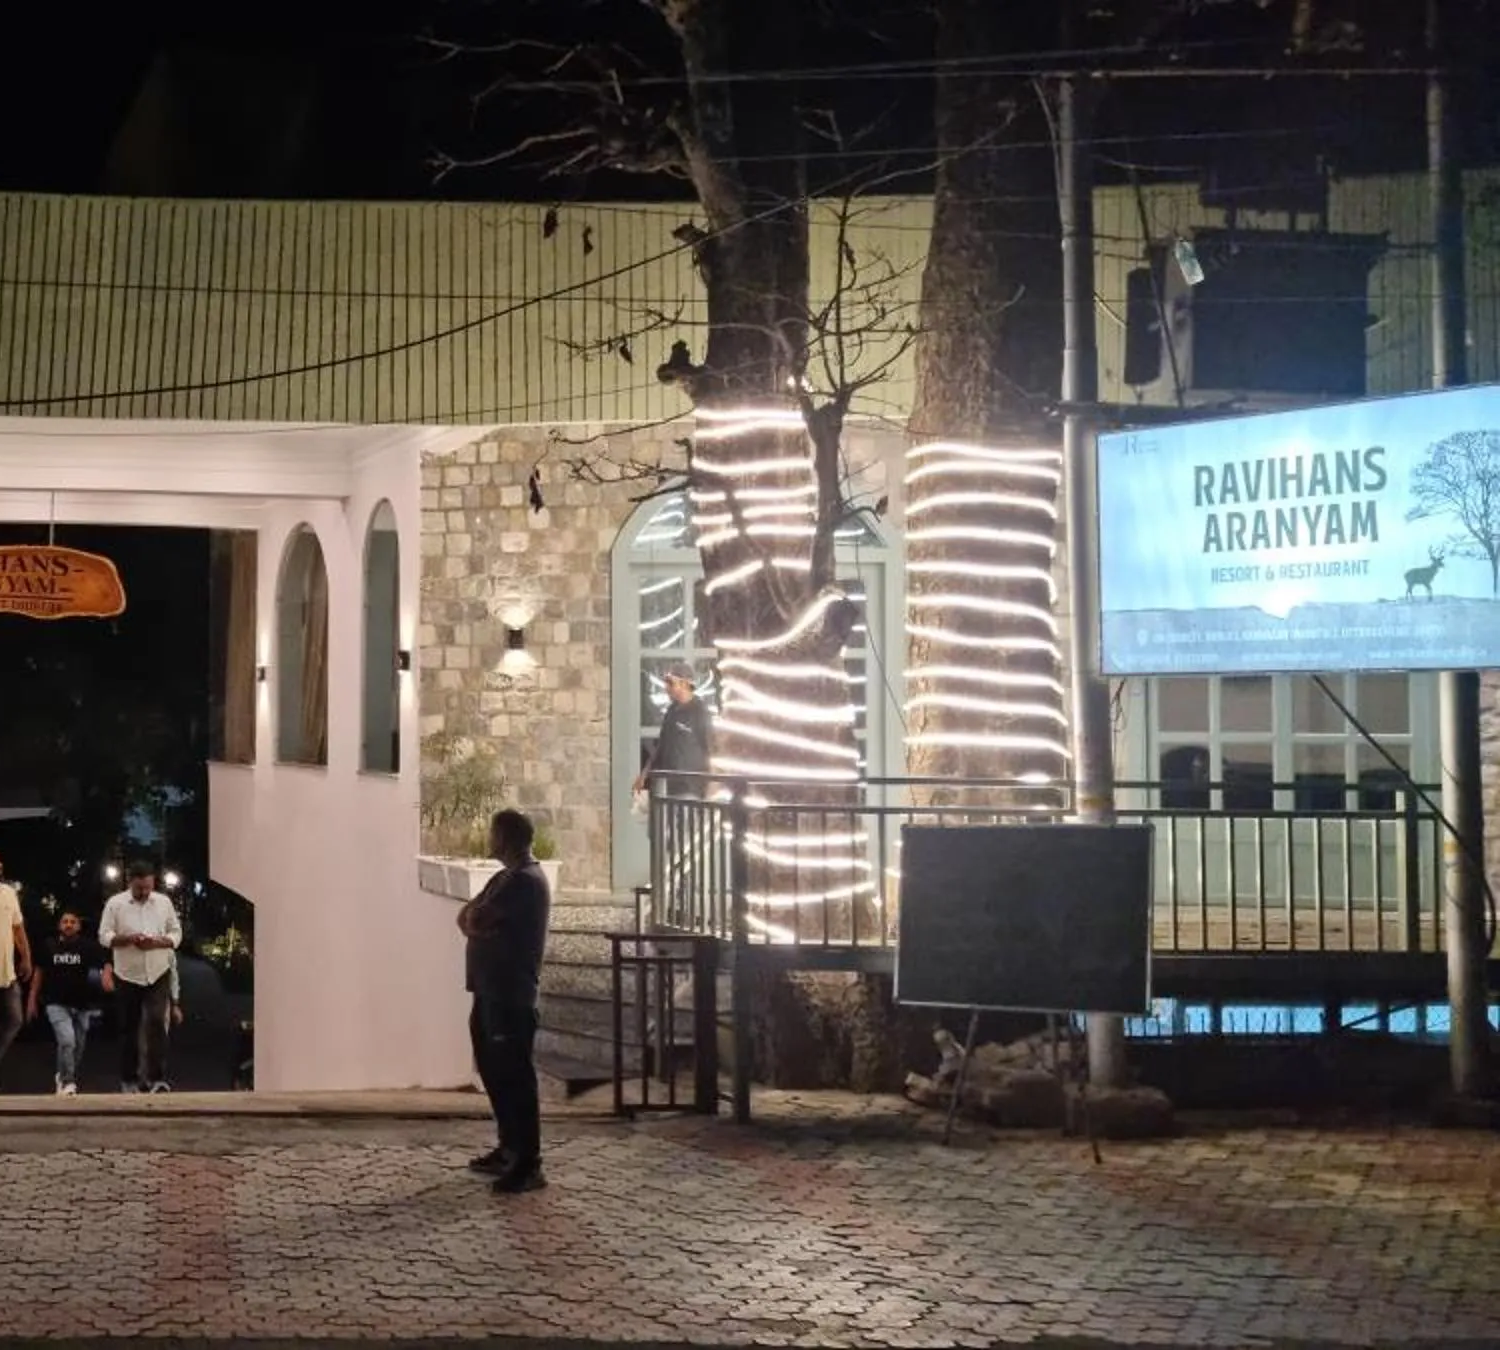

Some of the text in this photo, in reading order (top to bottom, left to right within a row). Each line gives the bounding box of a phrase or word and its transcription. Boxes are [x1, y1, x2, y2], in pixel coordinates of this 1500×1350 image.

[1193, 446, 1388, 506] RAVIHANS
[1202, 500, 1379, 553] ARANYAM
[1211, 559, 1371, 585] RESORT & RESTAURANT
